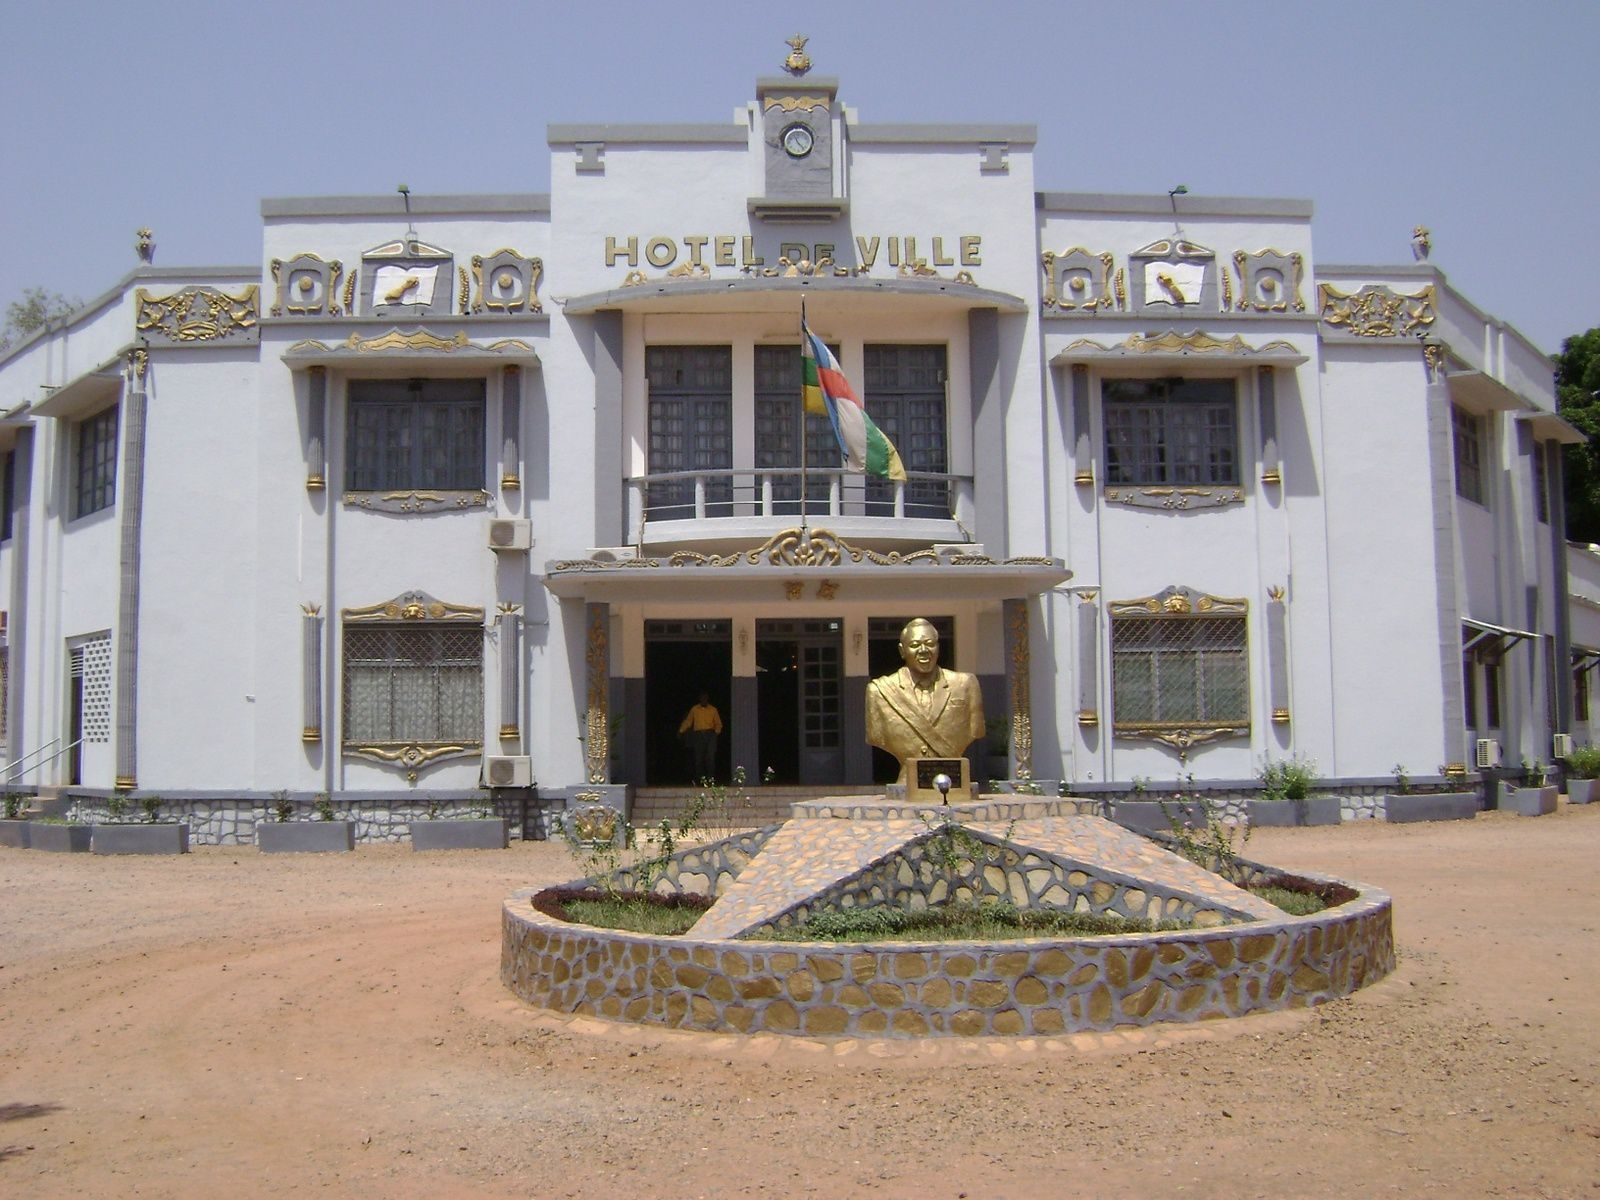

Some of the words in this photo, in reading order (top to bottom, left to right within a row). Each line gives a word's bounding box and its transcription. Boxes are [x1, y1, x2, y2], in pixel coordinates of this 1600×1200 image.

[605, 236, 764, 267] HOTEL
[780, 243, 835, 266] DE
[856, 236, 982, 267] VILLE
